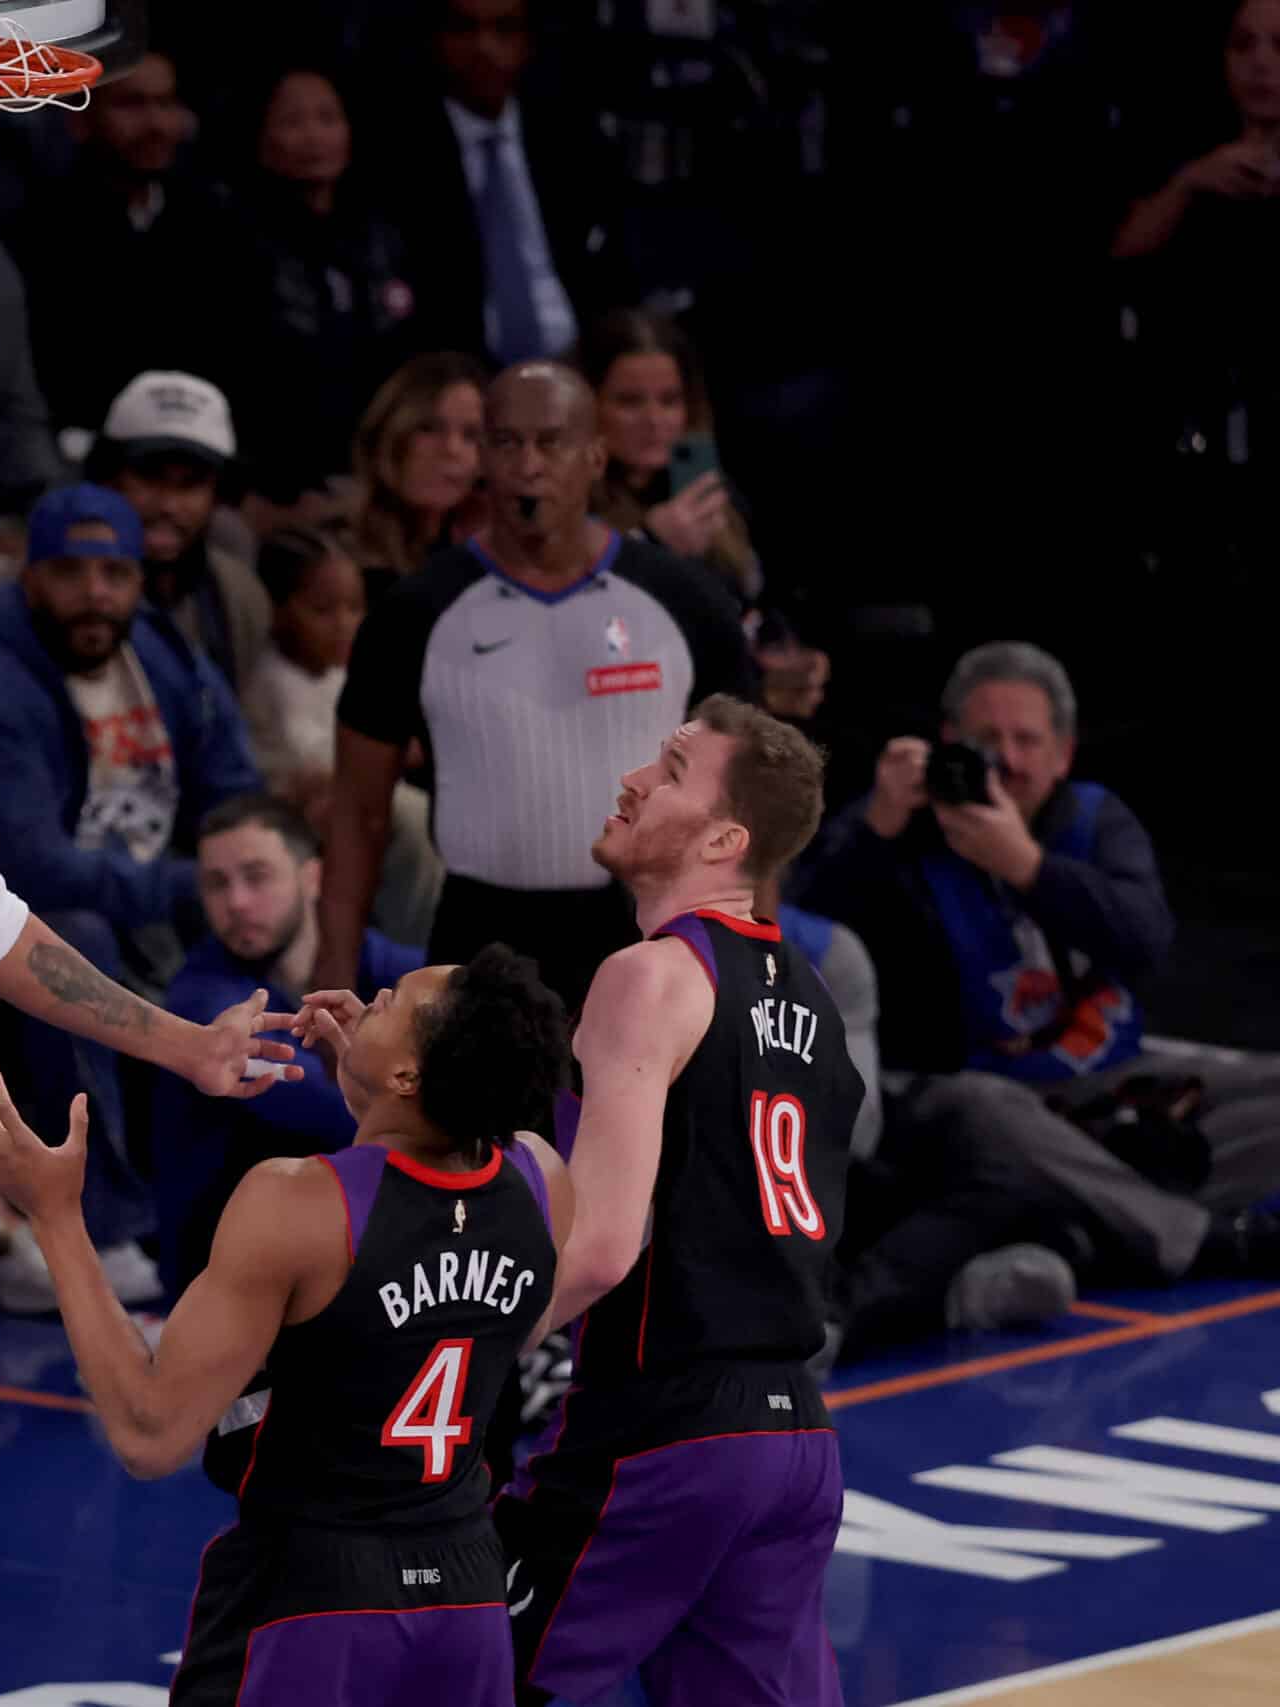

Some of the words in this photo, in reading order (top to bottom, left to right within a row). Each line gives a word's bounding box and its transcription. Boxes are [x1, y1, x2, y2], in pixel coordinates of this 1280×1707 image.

[749, 1089, 827, 1241] 19
[378, 1249, 535, 1329] BARNES
[380, 1337, 476, 1484] 4
